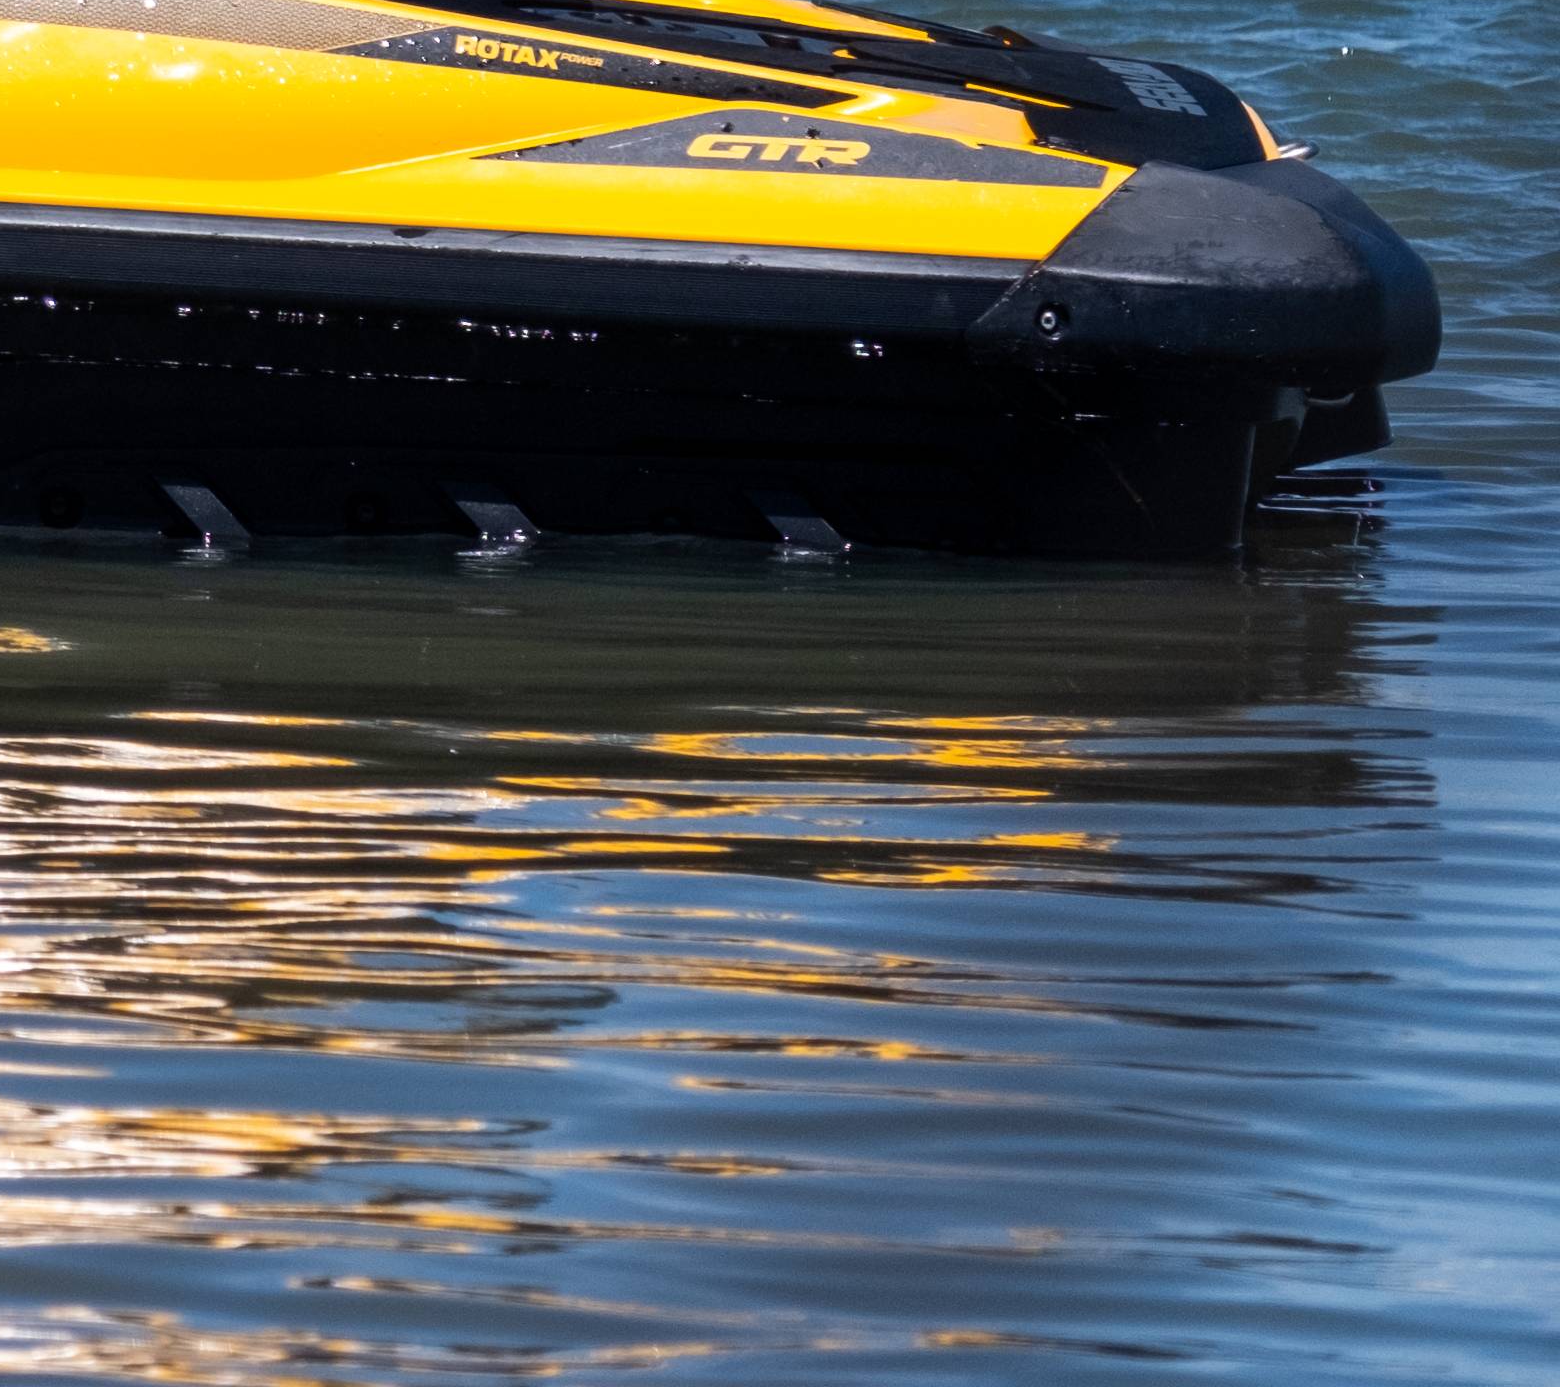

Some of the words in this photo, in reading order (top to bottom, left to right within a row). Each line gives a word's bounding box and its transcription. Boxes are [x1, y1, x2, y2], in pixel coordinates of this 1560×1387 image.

[454, 34, 561, 71] ROTAX
[559, 52, 605, 68] POWER
[686, 133, 871, 166] GTR
